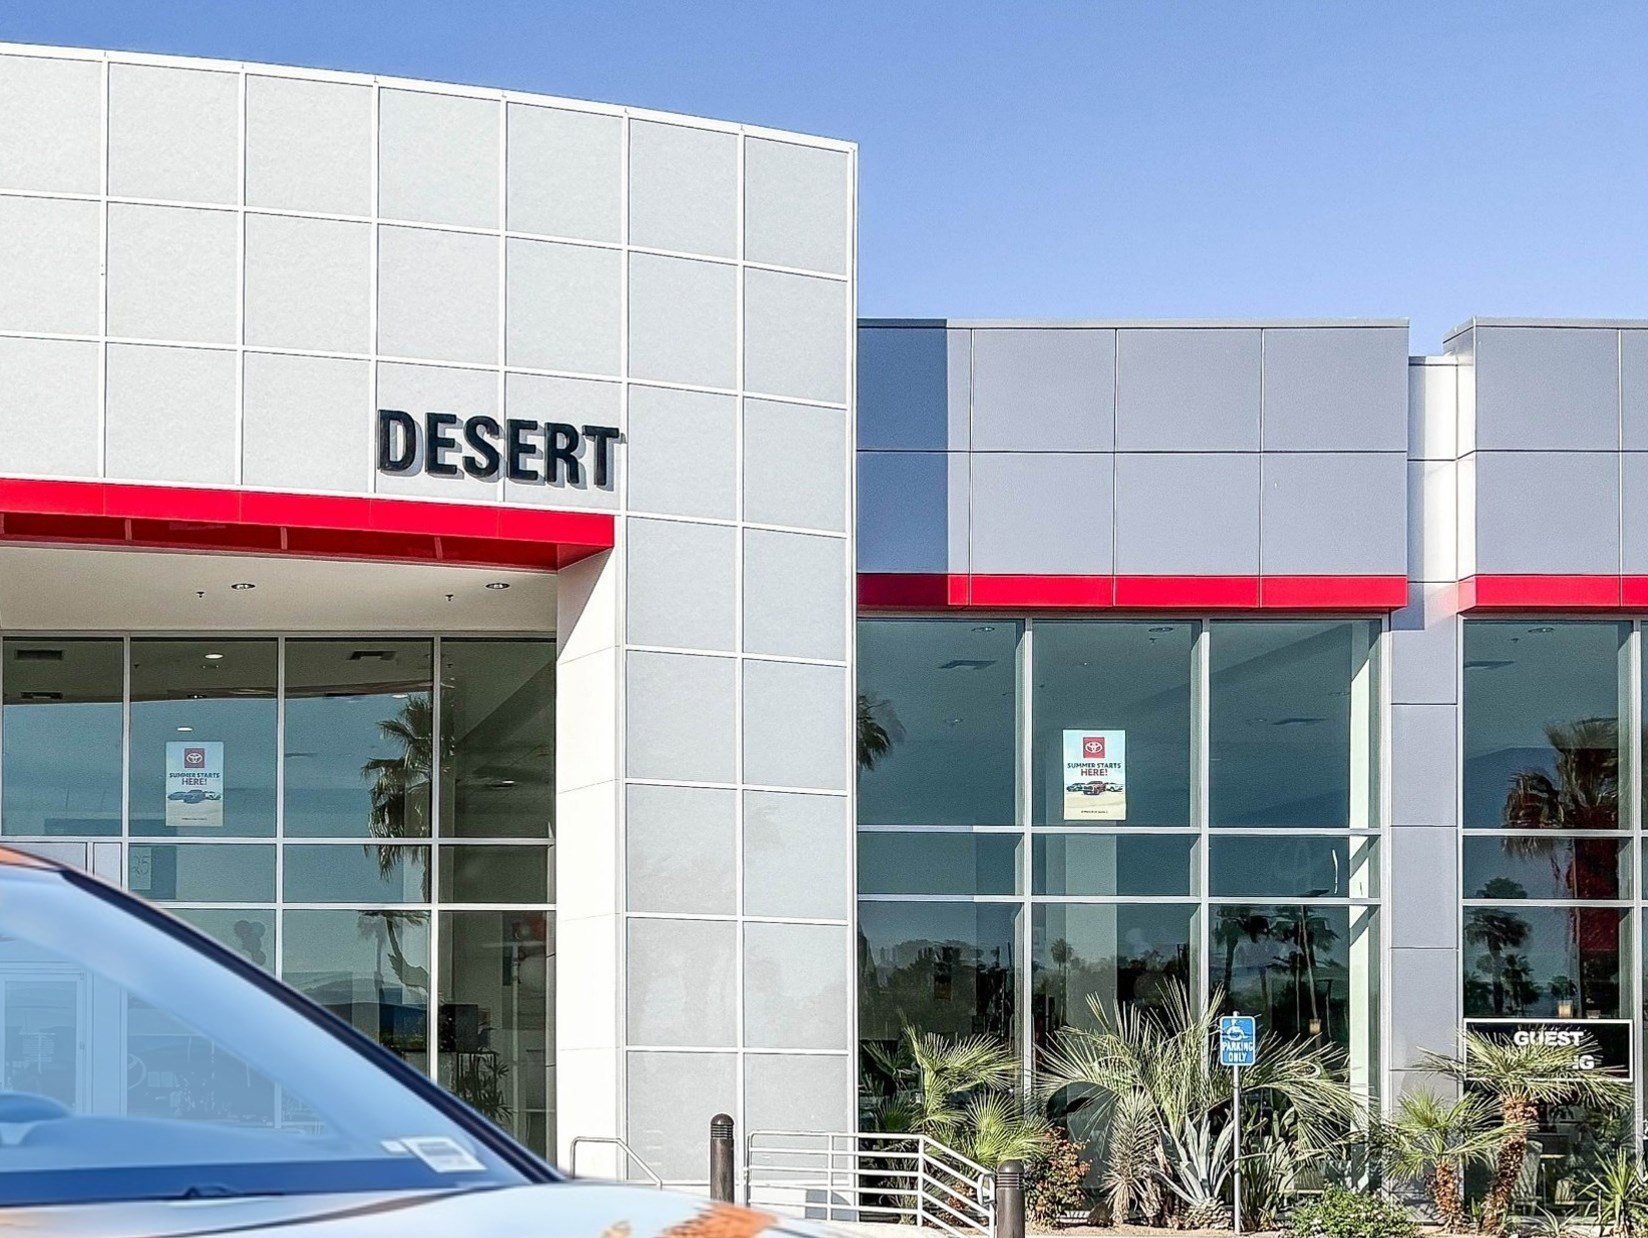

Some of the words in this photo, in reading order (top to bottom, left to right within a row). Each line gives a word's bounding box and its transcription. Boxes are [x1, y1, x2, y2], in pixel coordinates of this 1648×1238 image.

[377, 409, 620, 487] DESERT
[1080, 768, 1108, 776] HERE!
[181, 777, 208, 786] HERE!
[1513, 1030, 1584, 1047] GUEST
[1222, 1041, 1253, 1052] PARKING
[1228, 1051, 1248, 1063] ONLY
